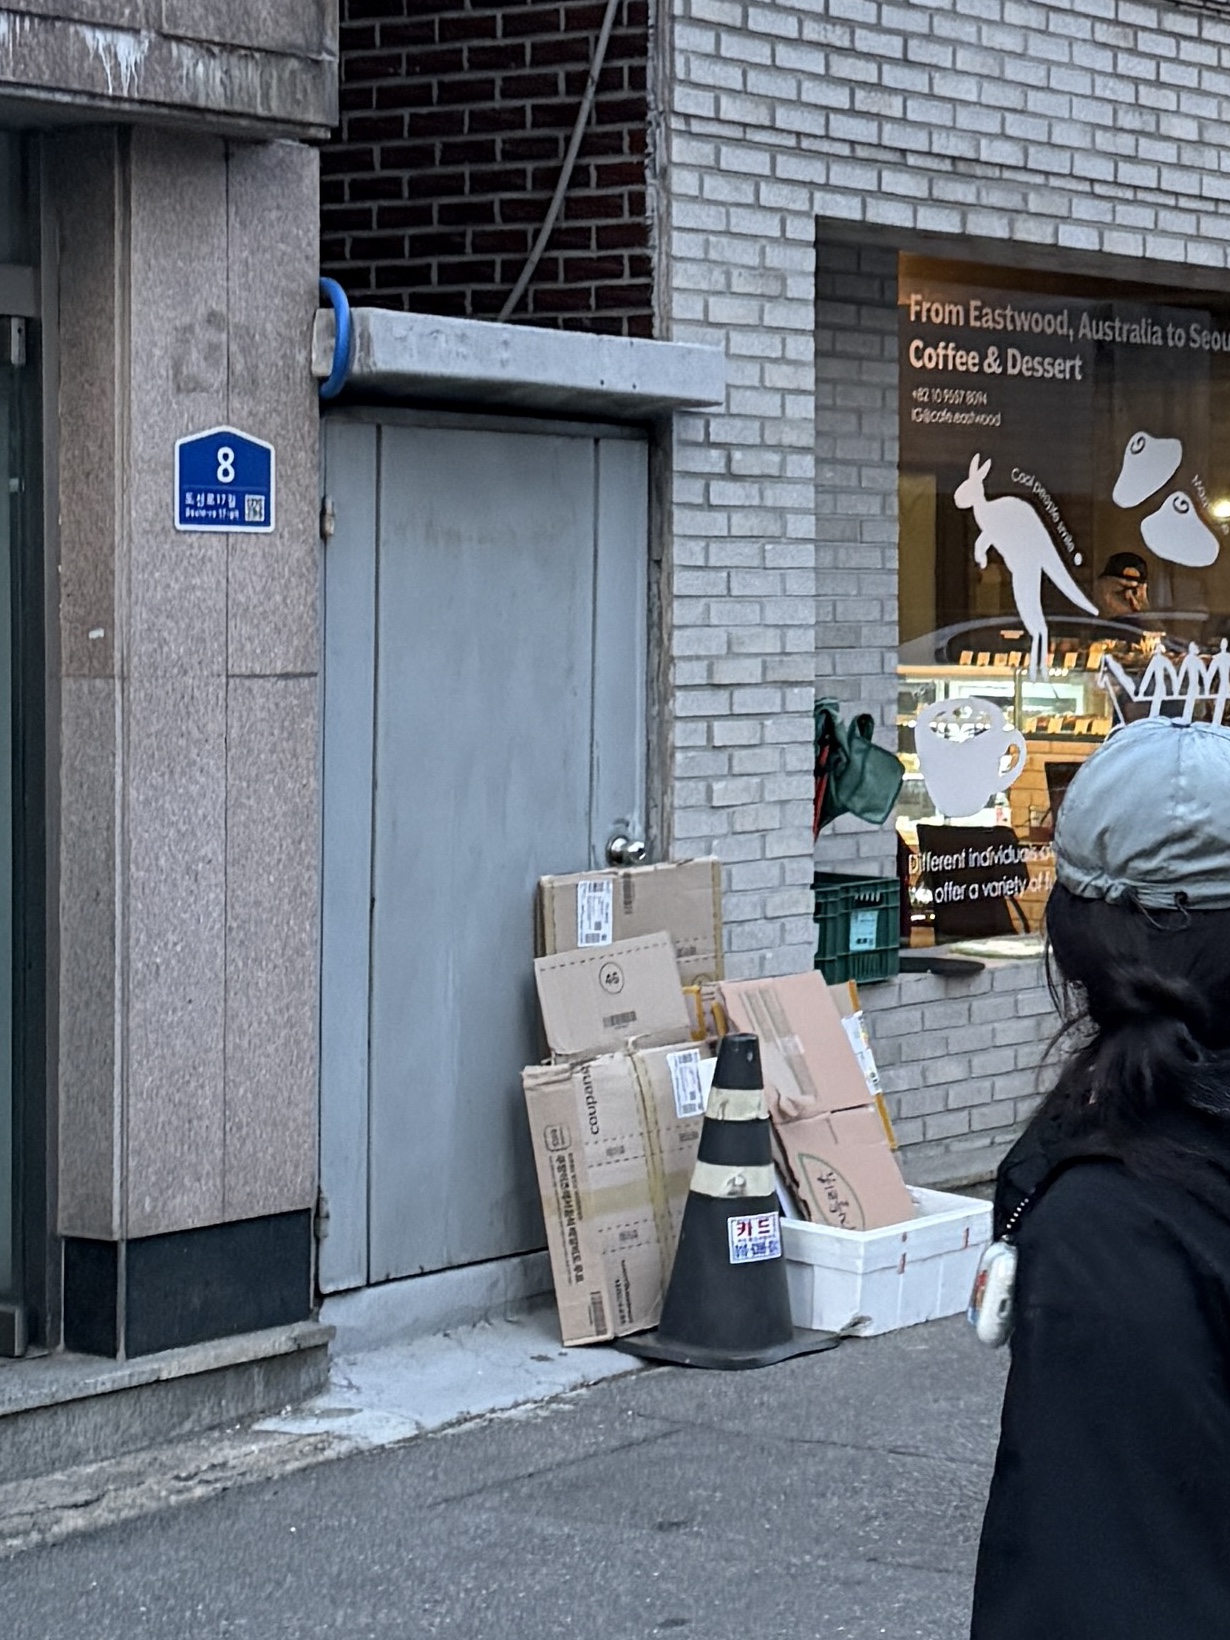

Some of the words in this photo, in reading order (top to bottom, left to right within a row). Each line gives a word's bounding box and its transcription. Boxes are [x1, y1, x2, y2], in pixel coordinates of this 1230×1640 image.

[909, 293, 964, 326] From
[969, 300, 1075, 343] Eastwood,
[1078, 311, 1163, 347] Australia
[1166, 326, 1186, 348] to
[908, 338, 980, 373] Coffee
[982, 346, 1003, 375] &
[1006, 347, 1083, 381] Dessert
[216, 446, 235, 483] 8
[1010, 467, 1035, 487] Cool
[908, 848, 966, 875] Different
[968, 843, 1038, 868] individuals
[934, 881, 967, 904] offer
[968, 884, 979, 900] a
[982, 875, 1027, 900] variety
[580, 1066, 600, 1136] coupang
[737, 1219, 770, 1237] 카드
